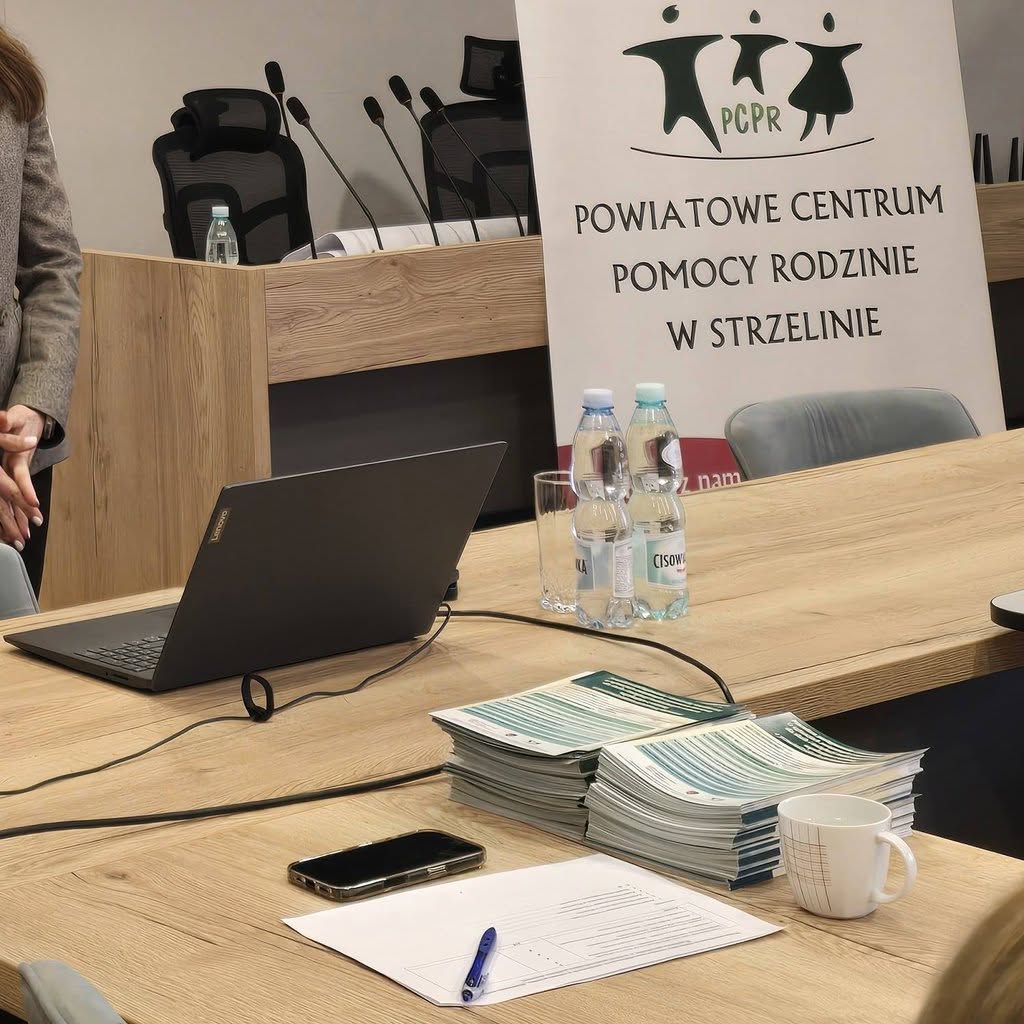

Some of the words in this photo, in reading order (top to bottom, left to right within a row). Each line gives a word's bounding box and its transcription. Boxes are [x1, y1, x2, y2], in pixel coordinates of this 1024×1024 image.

[720, 101, 783, 135] PCPR
[575, 193, 782, 234] POWIATOWE
[790, 184, 945, 222] CENTRUM
[612, 255, 758, 293] POMOCY
[771, 245, 919, 284] RODZINIE
[666, 319, 698, 351] W
[710, 307, 882, 348] STRZELINIE
[653, 553, 686, 569] CISOW
